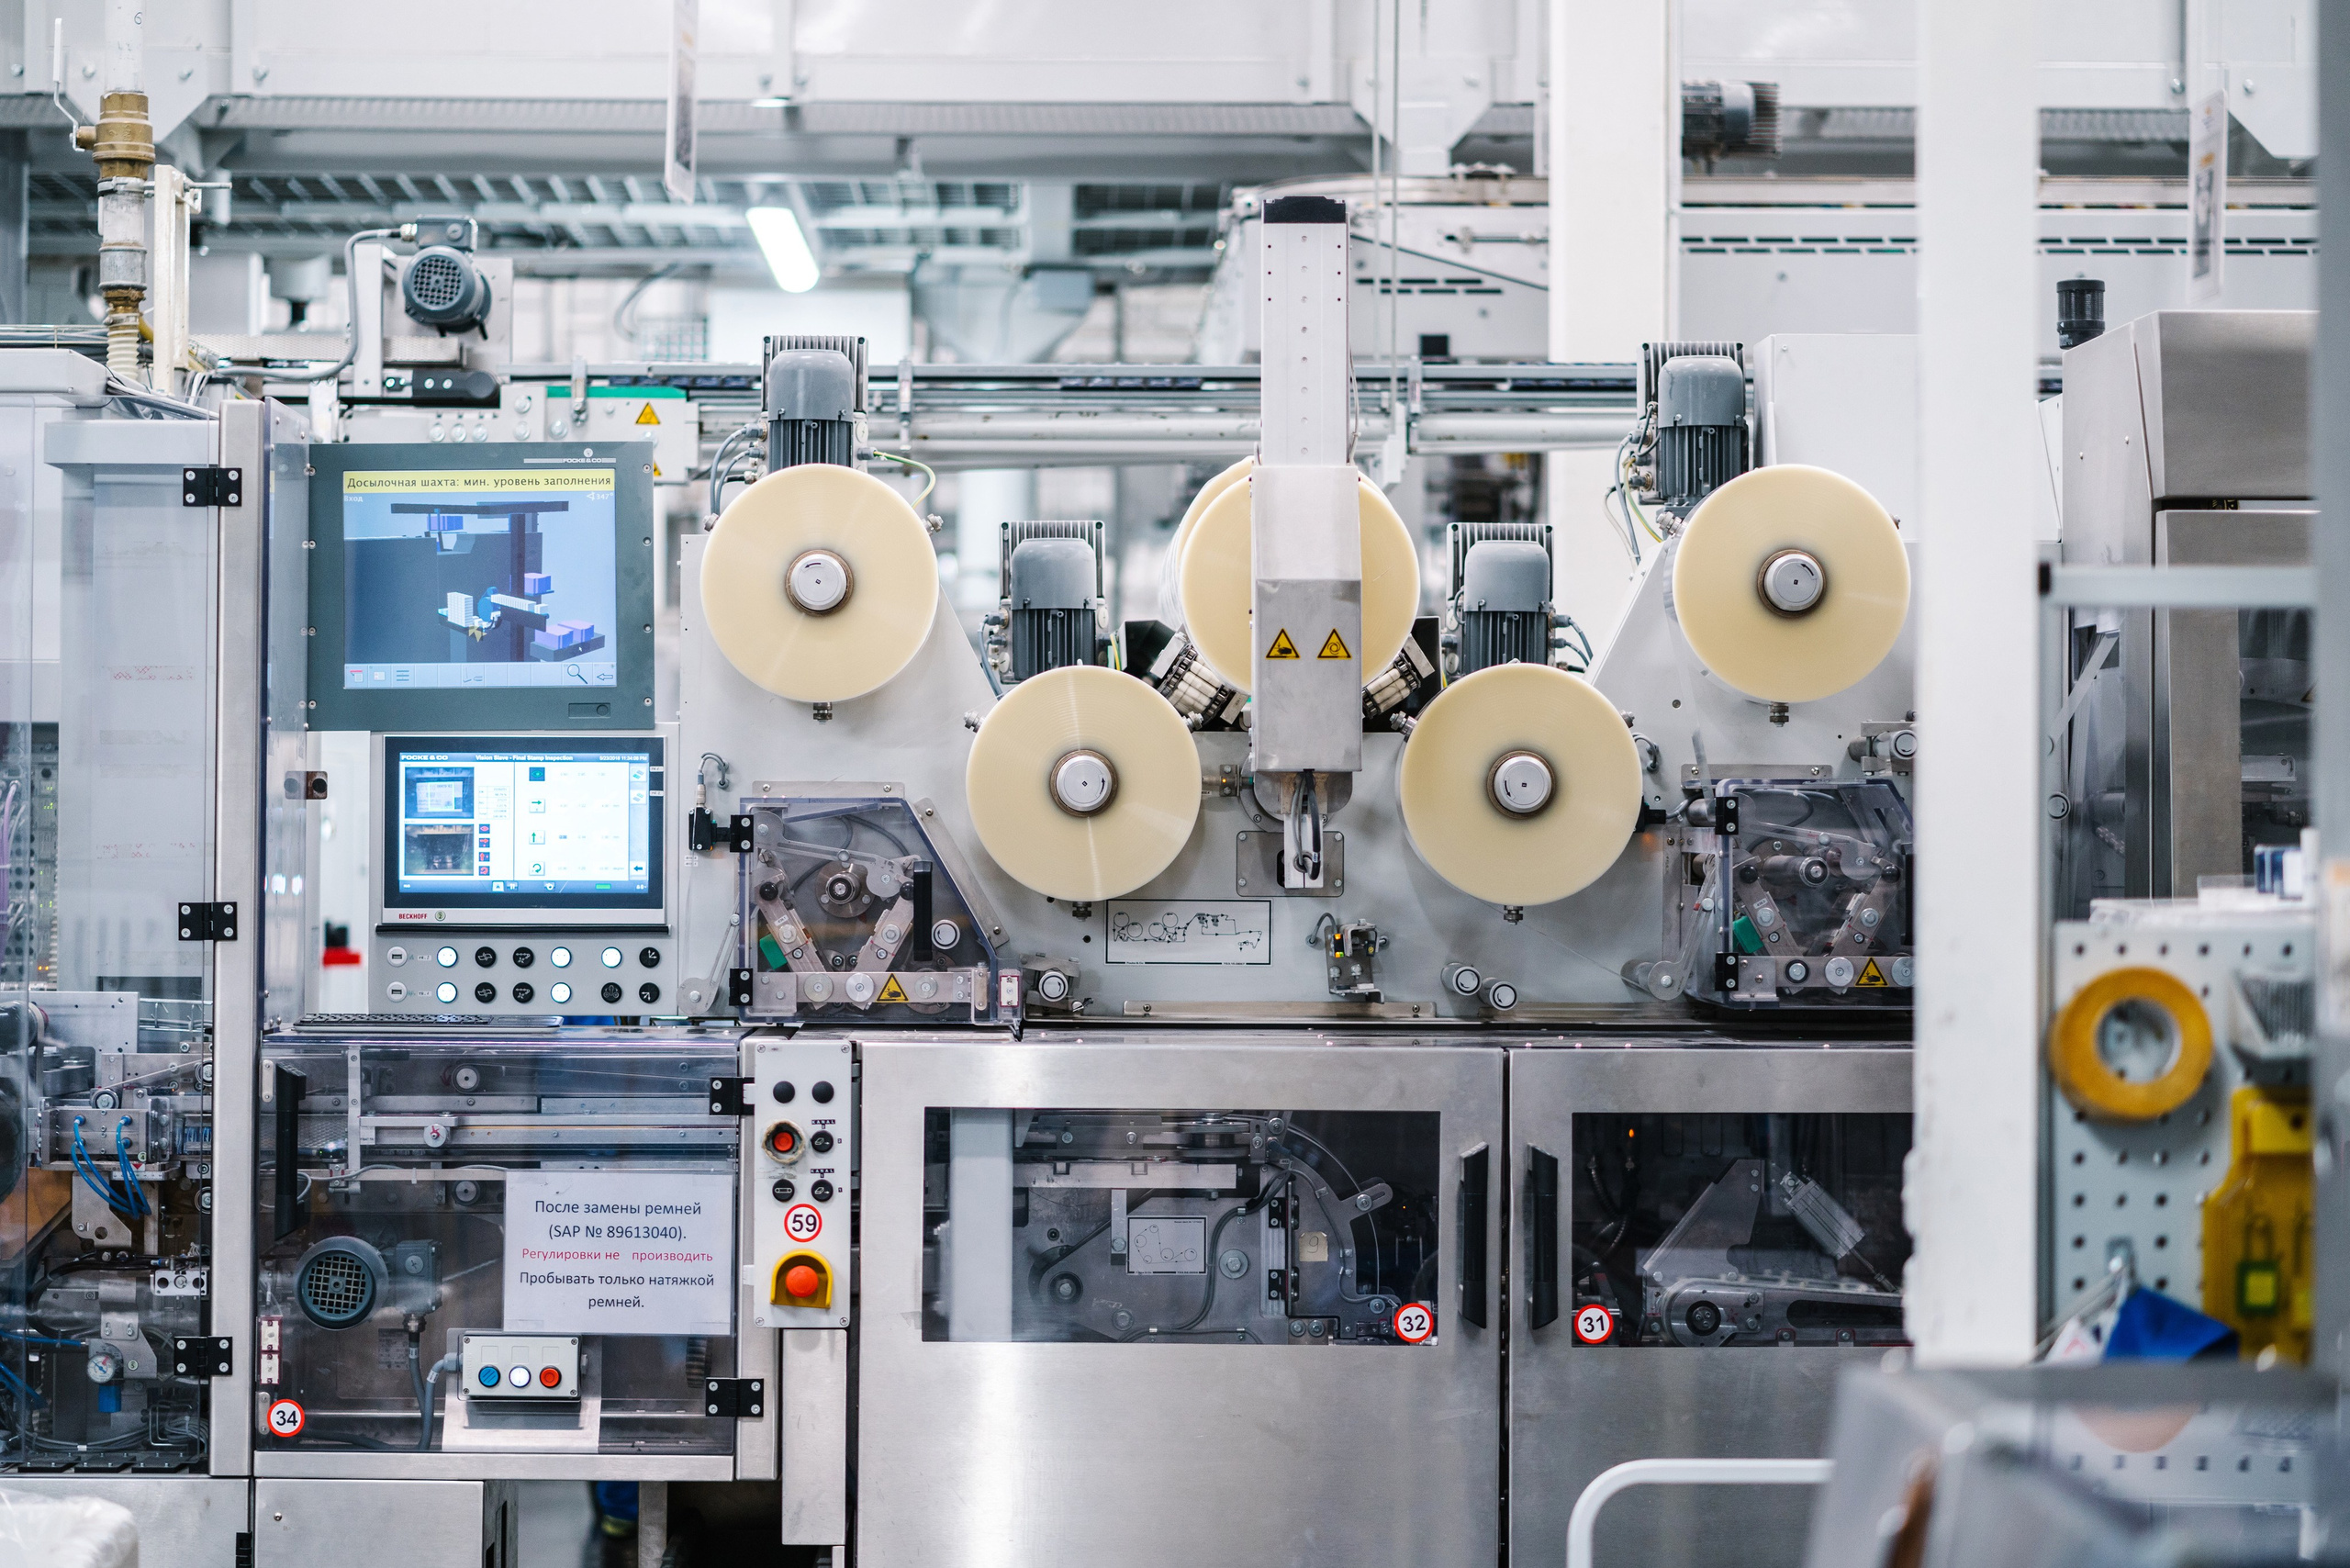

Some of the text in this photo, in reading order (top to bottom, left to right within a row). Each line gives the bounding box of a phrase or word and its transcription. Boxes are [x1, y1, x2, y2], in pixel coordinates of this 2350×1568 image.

[347, 477, 611, 490] Досылочная шахта: мин. уровень заполнения
[344, 495, 364, 503] Вход
[535, 1200, 701, 1217] После замены ремней
[791, 1214, 817, 1232] 59
[549, 1224, 687, 1242] (SAP № 89613040).
[522, 1248, 713, 1263] Регулировки не производить
[520, 1271, 714, 1287] Пробывать только натяжкой
[588, 1295, 644, 1310] ремней.
[1403, 1314, 1427, 1333] 32
[1583, 1315, 1606, 1334] 31
[275, 1410, 298, 1427] 34
